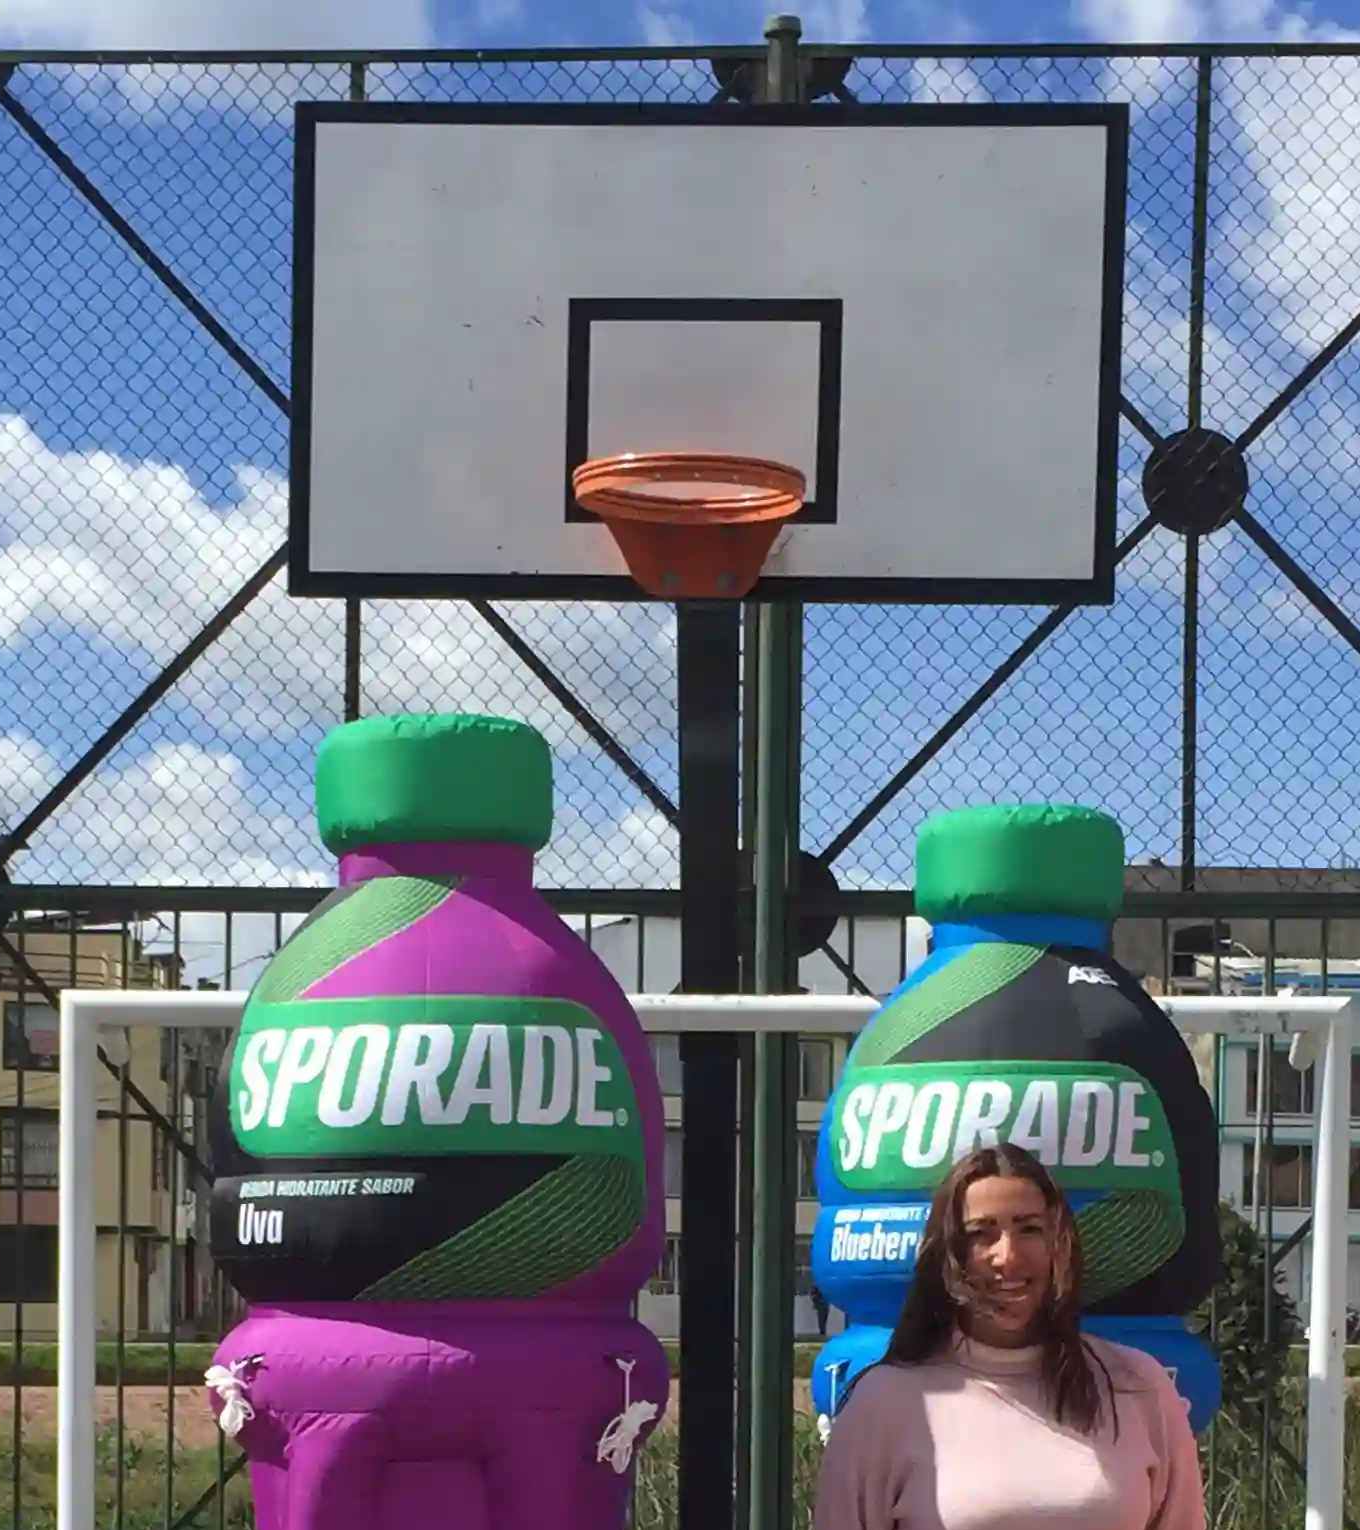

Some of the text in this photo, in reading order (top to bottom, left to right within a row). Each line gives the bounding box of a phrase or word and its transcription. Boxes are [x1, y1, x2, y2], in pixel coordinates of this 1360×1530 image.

[239, 1024, 614, 1131] SPORADE
[840, 1081, 1151, 1171] SPORADE
[360, 1177, 416, 1195] SABOR
[239, 1203, 284, 1245] Uva
